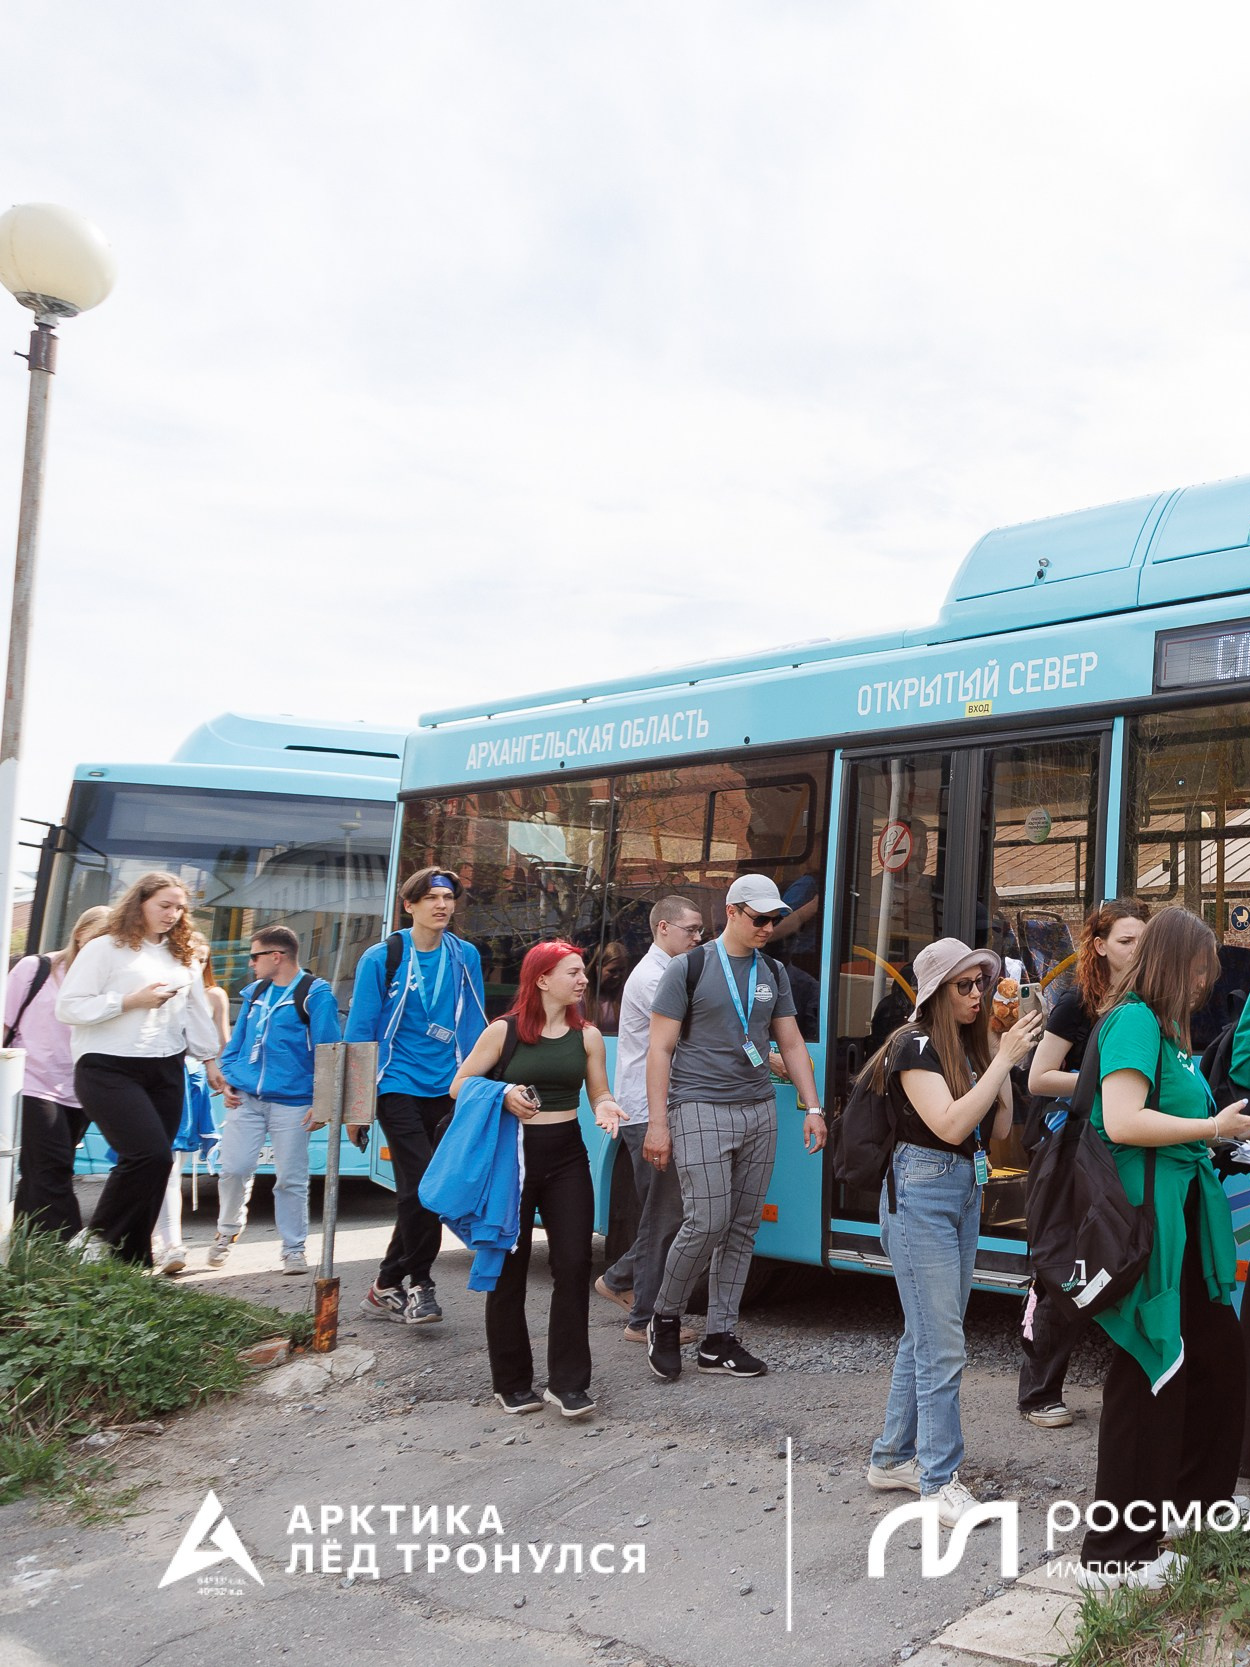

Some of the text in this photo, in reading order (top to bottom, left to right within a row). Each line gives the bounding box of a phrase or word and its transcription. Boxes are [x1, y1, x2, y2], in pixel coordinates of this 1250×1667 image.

[857, 651, 1098, 716] ОТКРЫТЫЙ СЕВЕР
[967, 703, 990, 714] ВХОД
[465, 709, 710, 770] АРХАНГЕЛЬСКАЯ ОБЛАСТЬ
